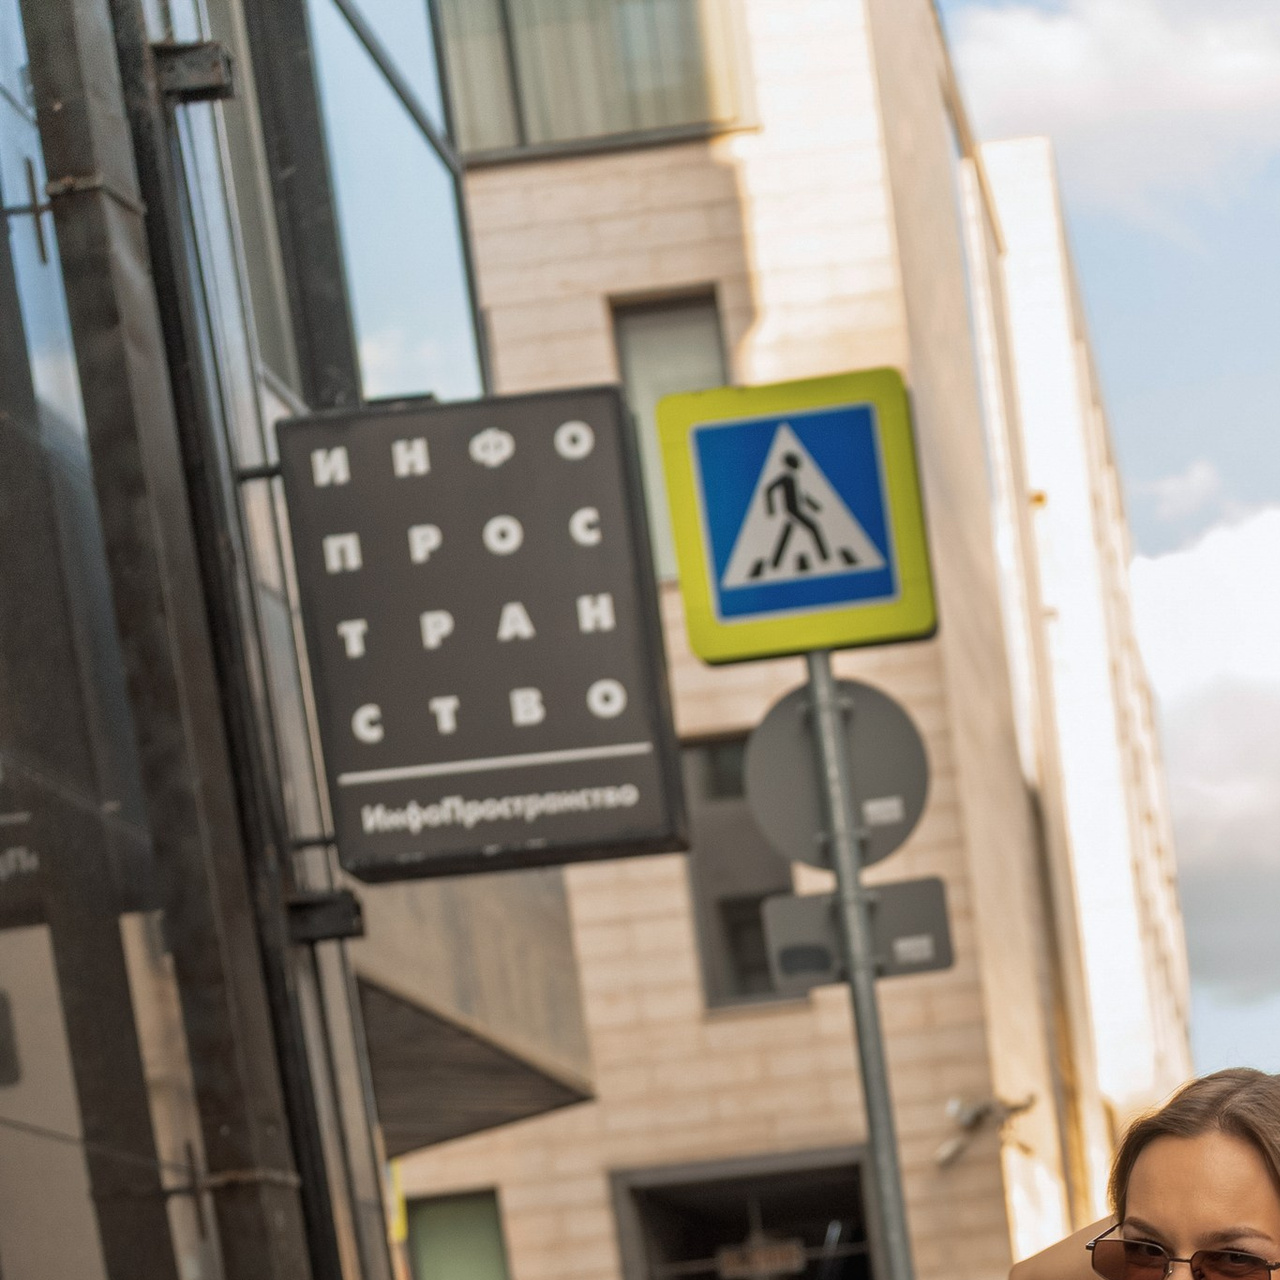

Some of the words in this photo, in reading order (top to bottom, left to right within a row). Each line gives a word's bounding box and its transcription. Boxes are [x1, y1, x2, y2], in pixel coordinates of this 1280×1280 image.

[311, 420, 595, 487] ИНФО
[323, 506, 602, 573] ПРОС
[337, 593, 616, 658] ТРАН
[352, 678, 628, 743] СТВО
